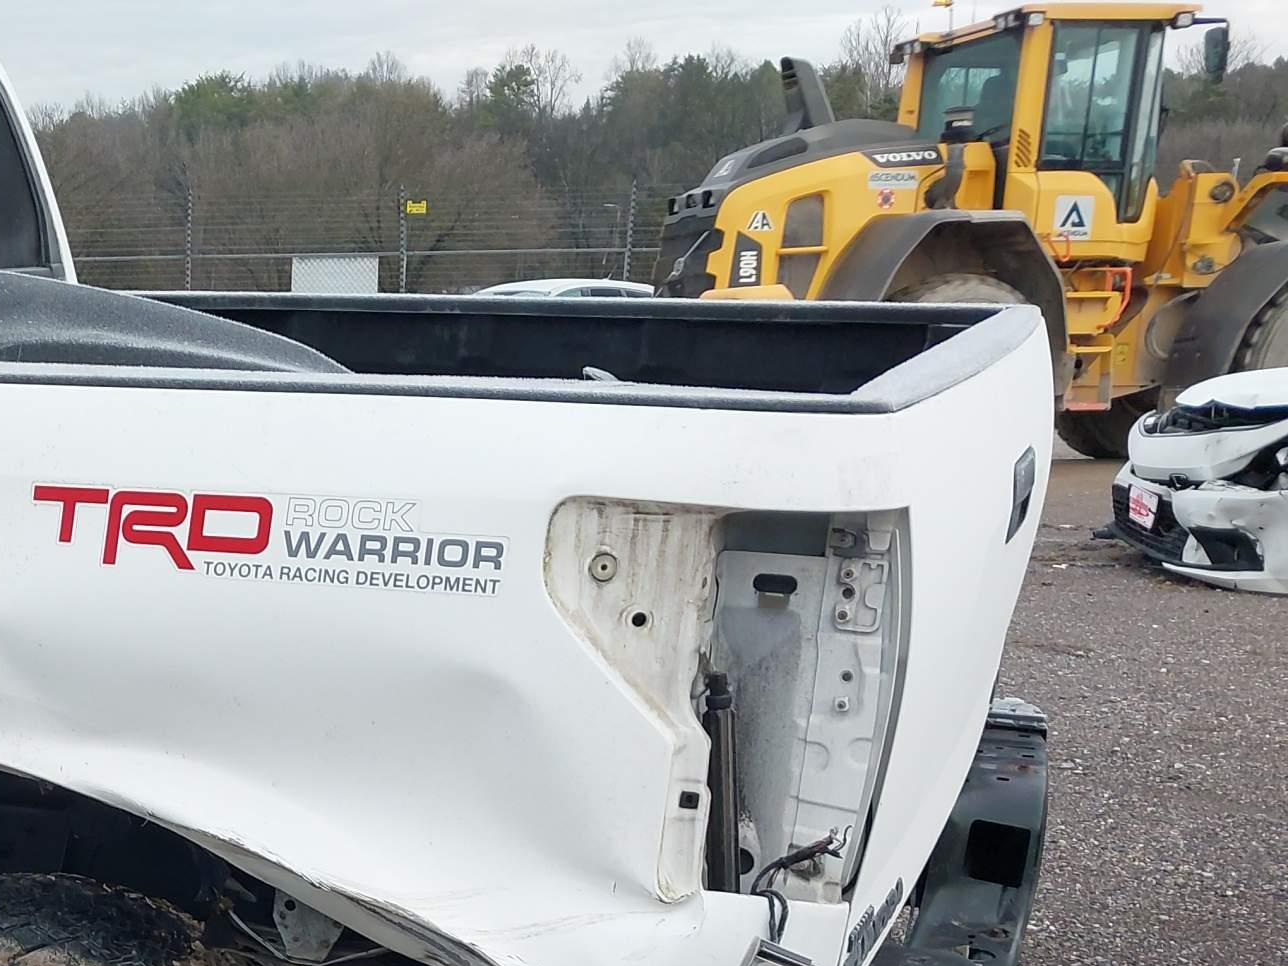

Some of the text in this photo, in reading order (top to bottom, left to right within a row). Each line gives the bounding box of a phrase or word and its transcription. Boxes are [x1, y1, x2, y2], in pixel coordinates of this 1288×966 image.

[872, 150, 938, 163] VOLVO
[739, 250, 759, 283] L90H
[32, 484, 274, 570] TRD
[285, 496, 418, 533] ROCK
[283, 529, 506, 571] WARRIOR
[203, 559, 501, 596] TOYOTA RACING DEVELOPMENT
